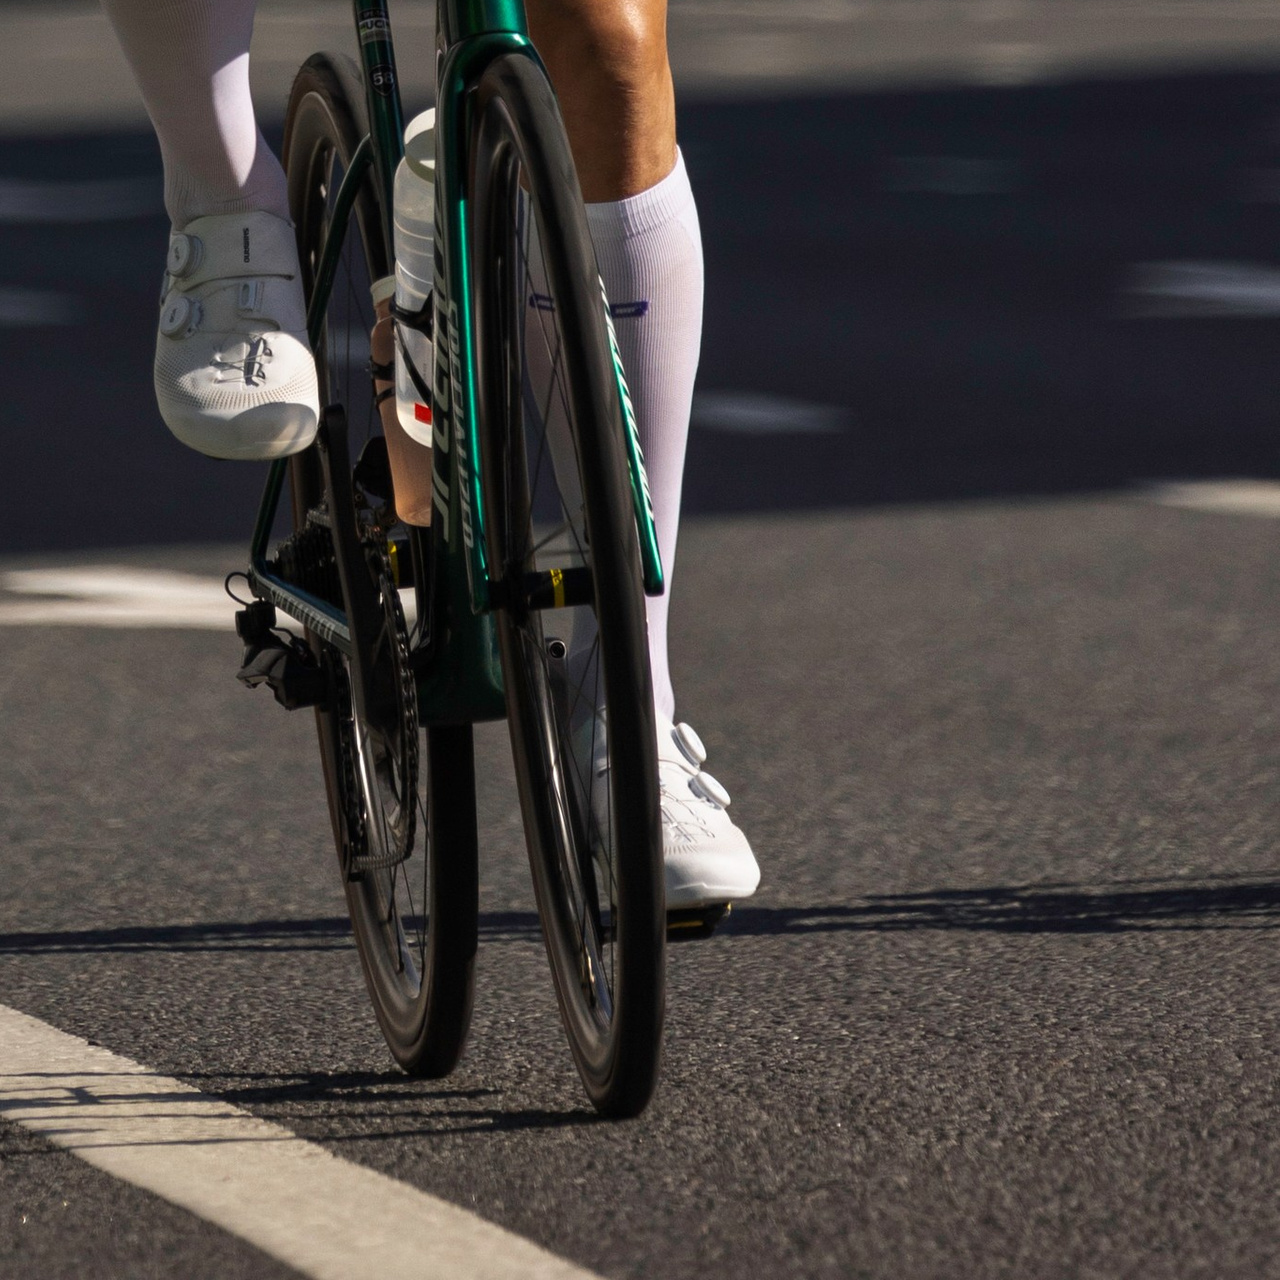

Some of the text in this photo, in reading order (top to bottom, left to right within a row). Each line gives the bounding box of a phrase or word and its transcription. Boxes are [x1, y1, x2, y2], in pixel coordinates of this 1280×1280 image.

[373, 71, 394, 86] 58
[243, 227, 251, 264] SHIMANO
[447, 297, 474, 549] SPECIALIZED
